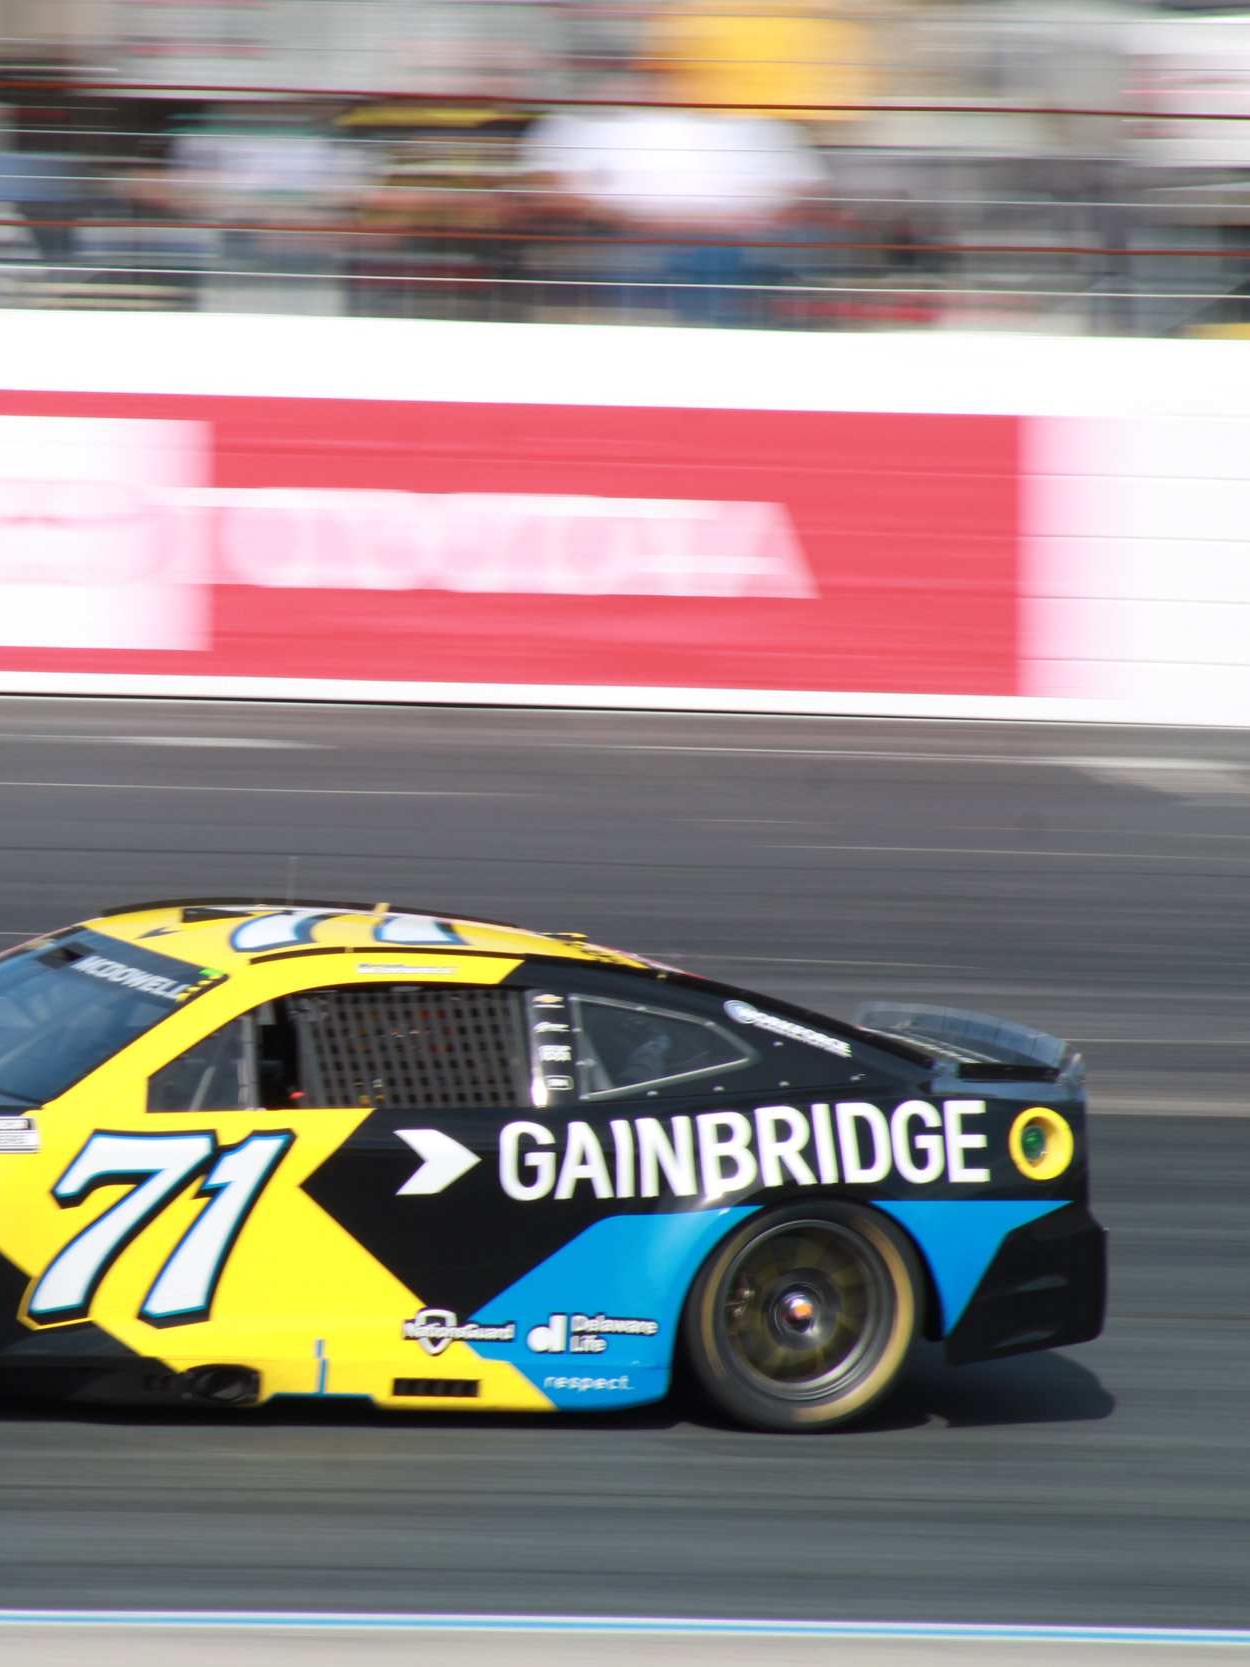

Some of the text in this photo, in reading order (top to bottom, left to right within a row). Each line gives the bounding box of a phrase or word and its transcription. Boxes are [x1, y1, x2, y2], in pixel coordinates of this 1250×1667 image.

[498, 1099, 990, 1201] GAINBRIDGE
[20, 1129, 296, 1329] 71
[570, 1316, 659, 1335] Delaware
[570, 1334, 607, 1353] Life
